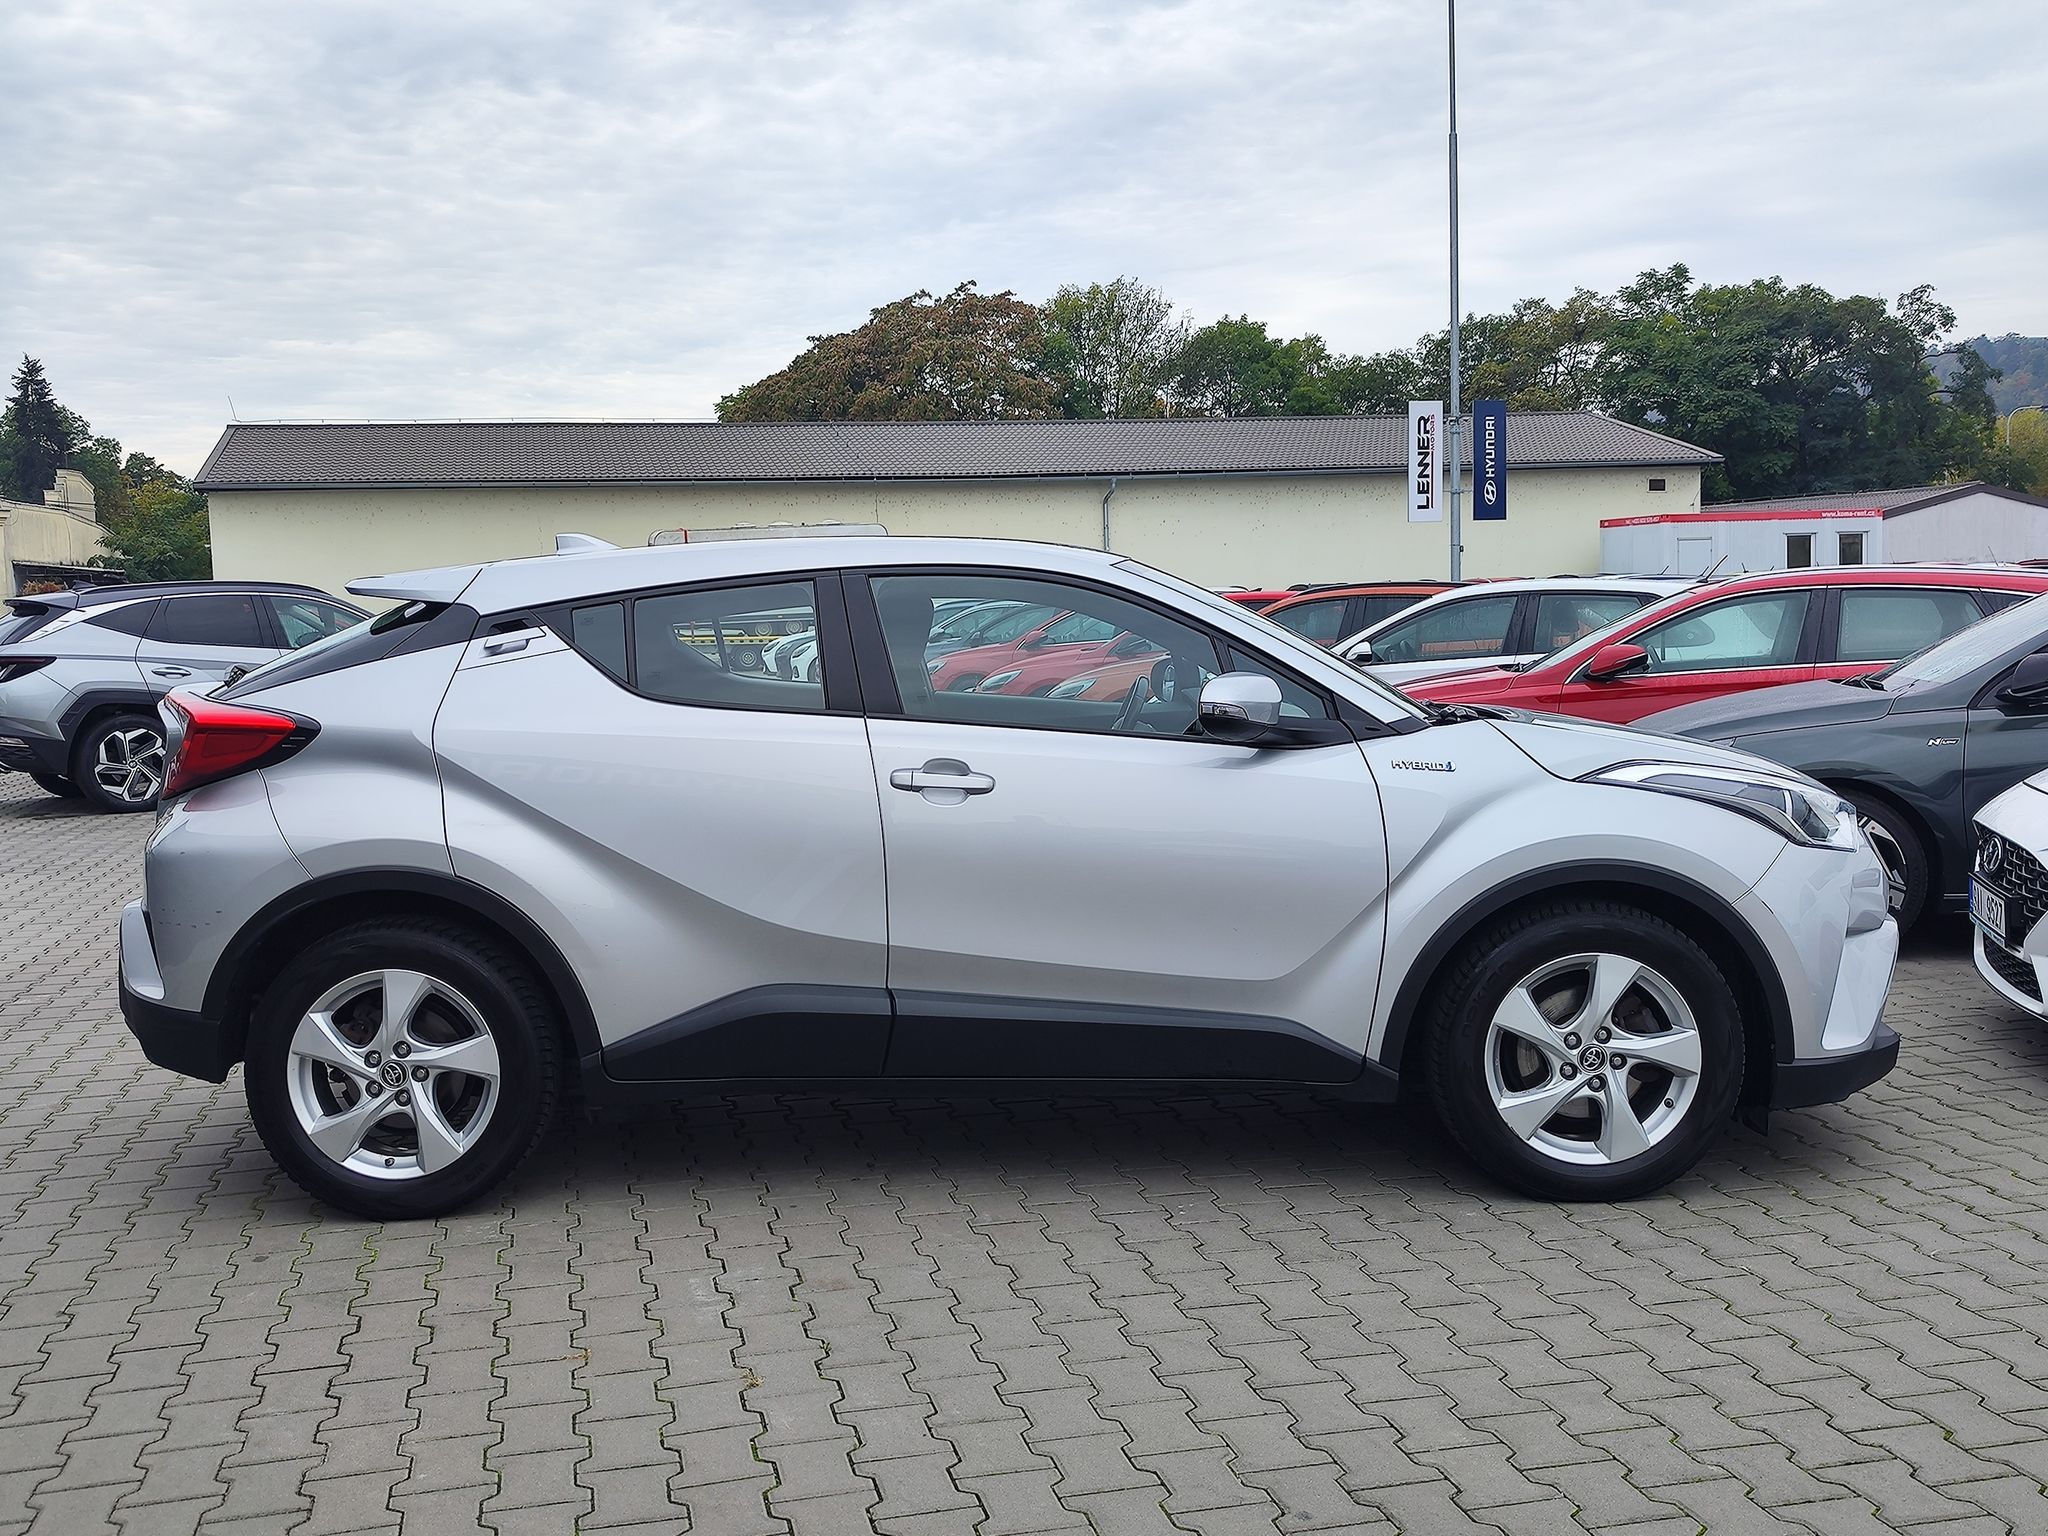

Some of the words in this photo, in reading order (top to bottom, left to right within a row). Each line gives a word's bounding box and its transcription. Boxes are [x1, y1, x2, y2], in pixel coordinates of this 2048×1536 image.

[1417, 415, 1430, 509] LENNER
[1485, 416, 1495, 478] HYUNDAI
[1391, 759, 1445, 771] HYBRID
